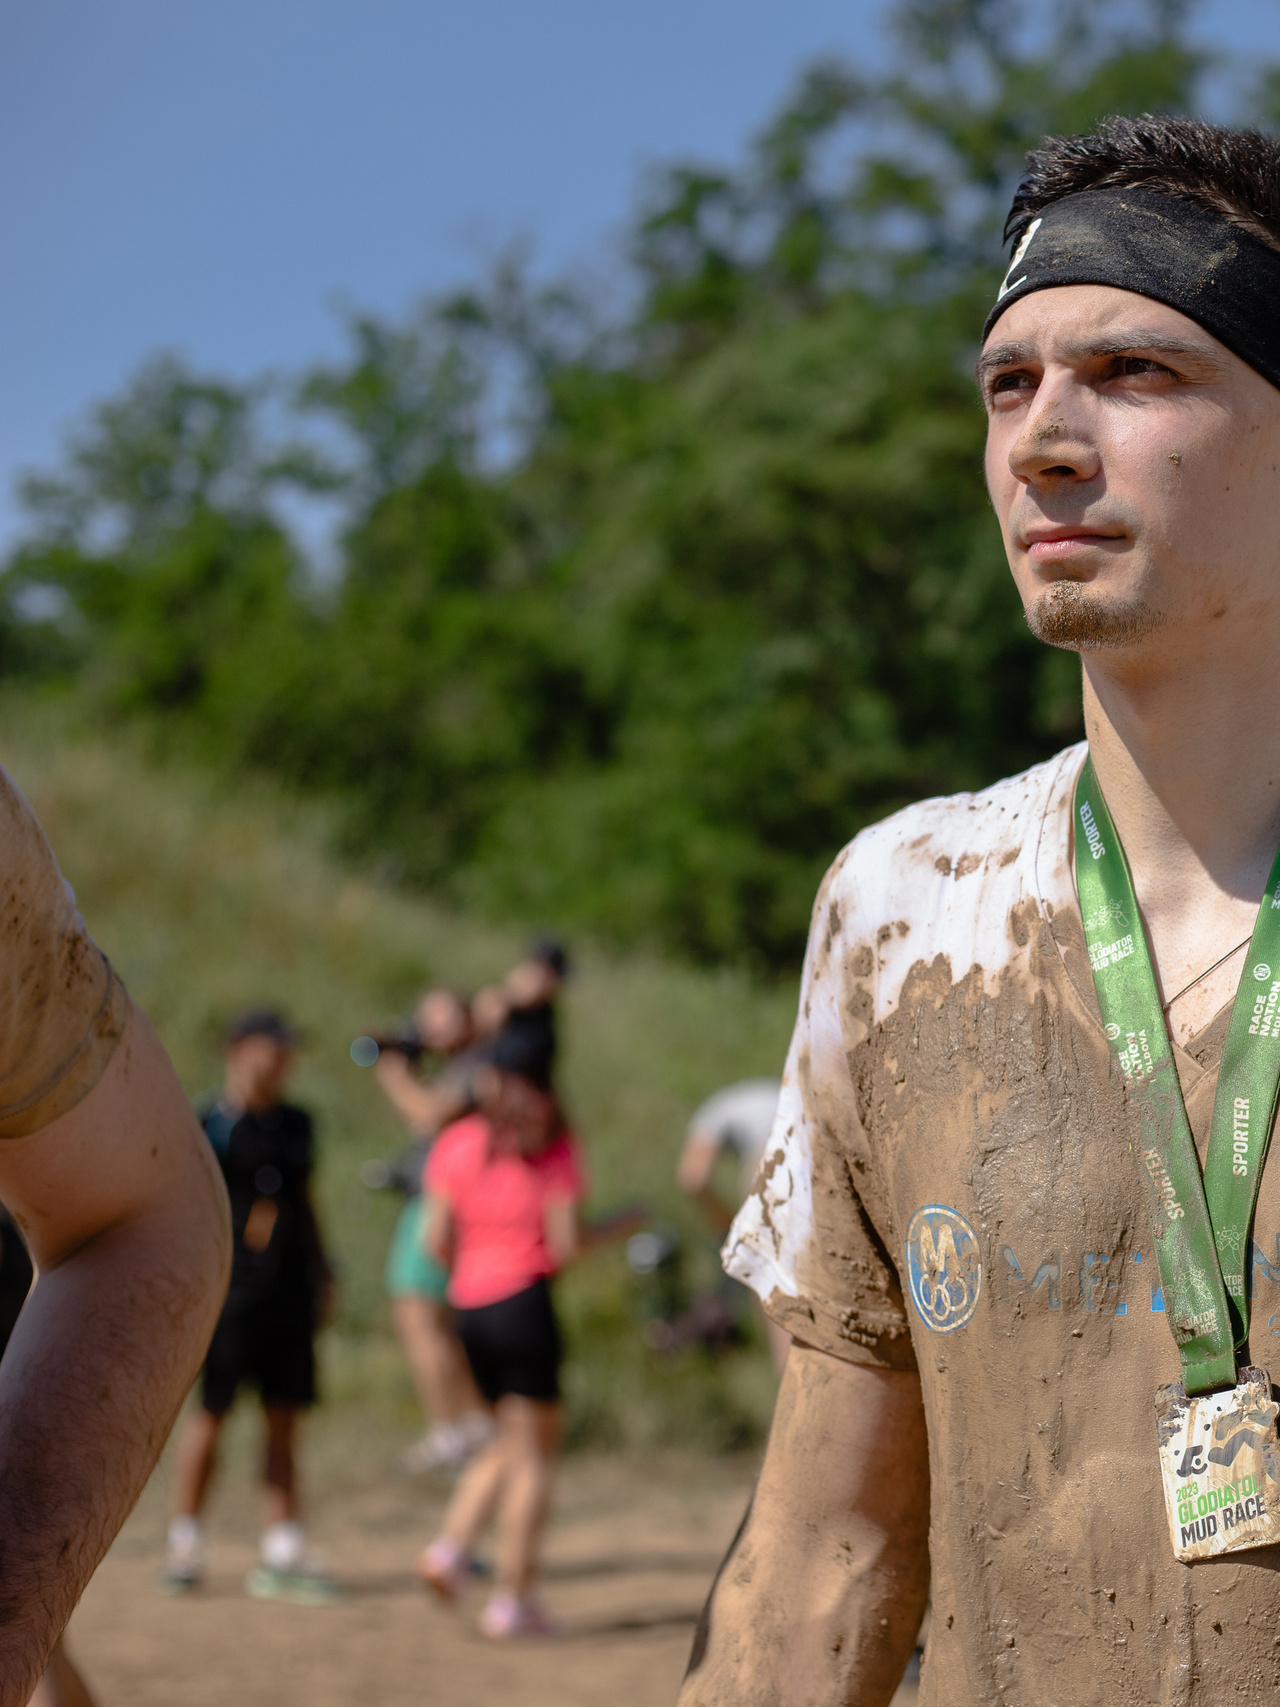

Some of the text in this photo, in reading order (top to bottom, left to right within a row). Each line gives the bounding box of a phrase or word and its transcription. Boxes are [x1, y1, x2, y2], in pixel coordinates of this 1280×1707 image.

[1079, 800, 1106, 860] SPORTER
[1087, 940, 1103, 953] 023
[1111, 943, 1135, 963] RACE
[1248, 994, 1267, 1035] RACE
[1139, 1029, 1156, 1083] OLDOVA
[1232, 1096, 1251, 1177] SPORTER
[1176, 1481, 1199, 1503] 2023
[1181, 1493, 1268, 1548] MUD RACE
